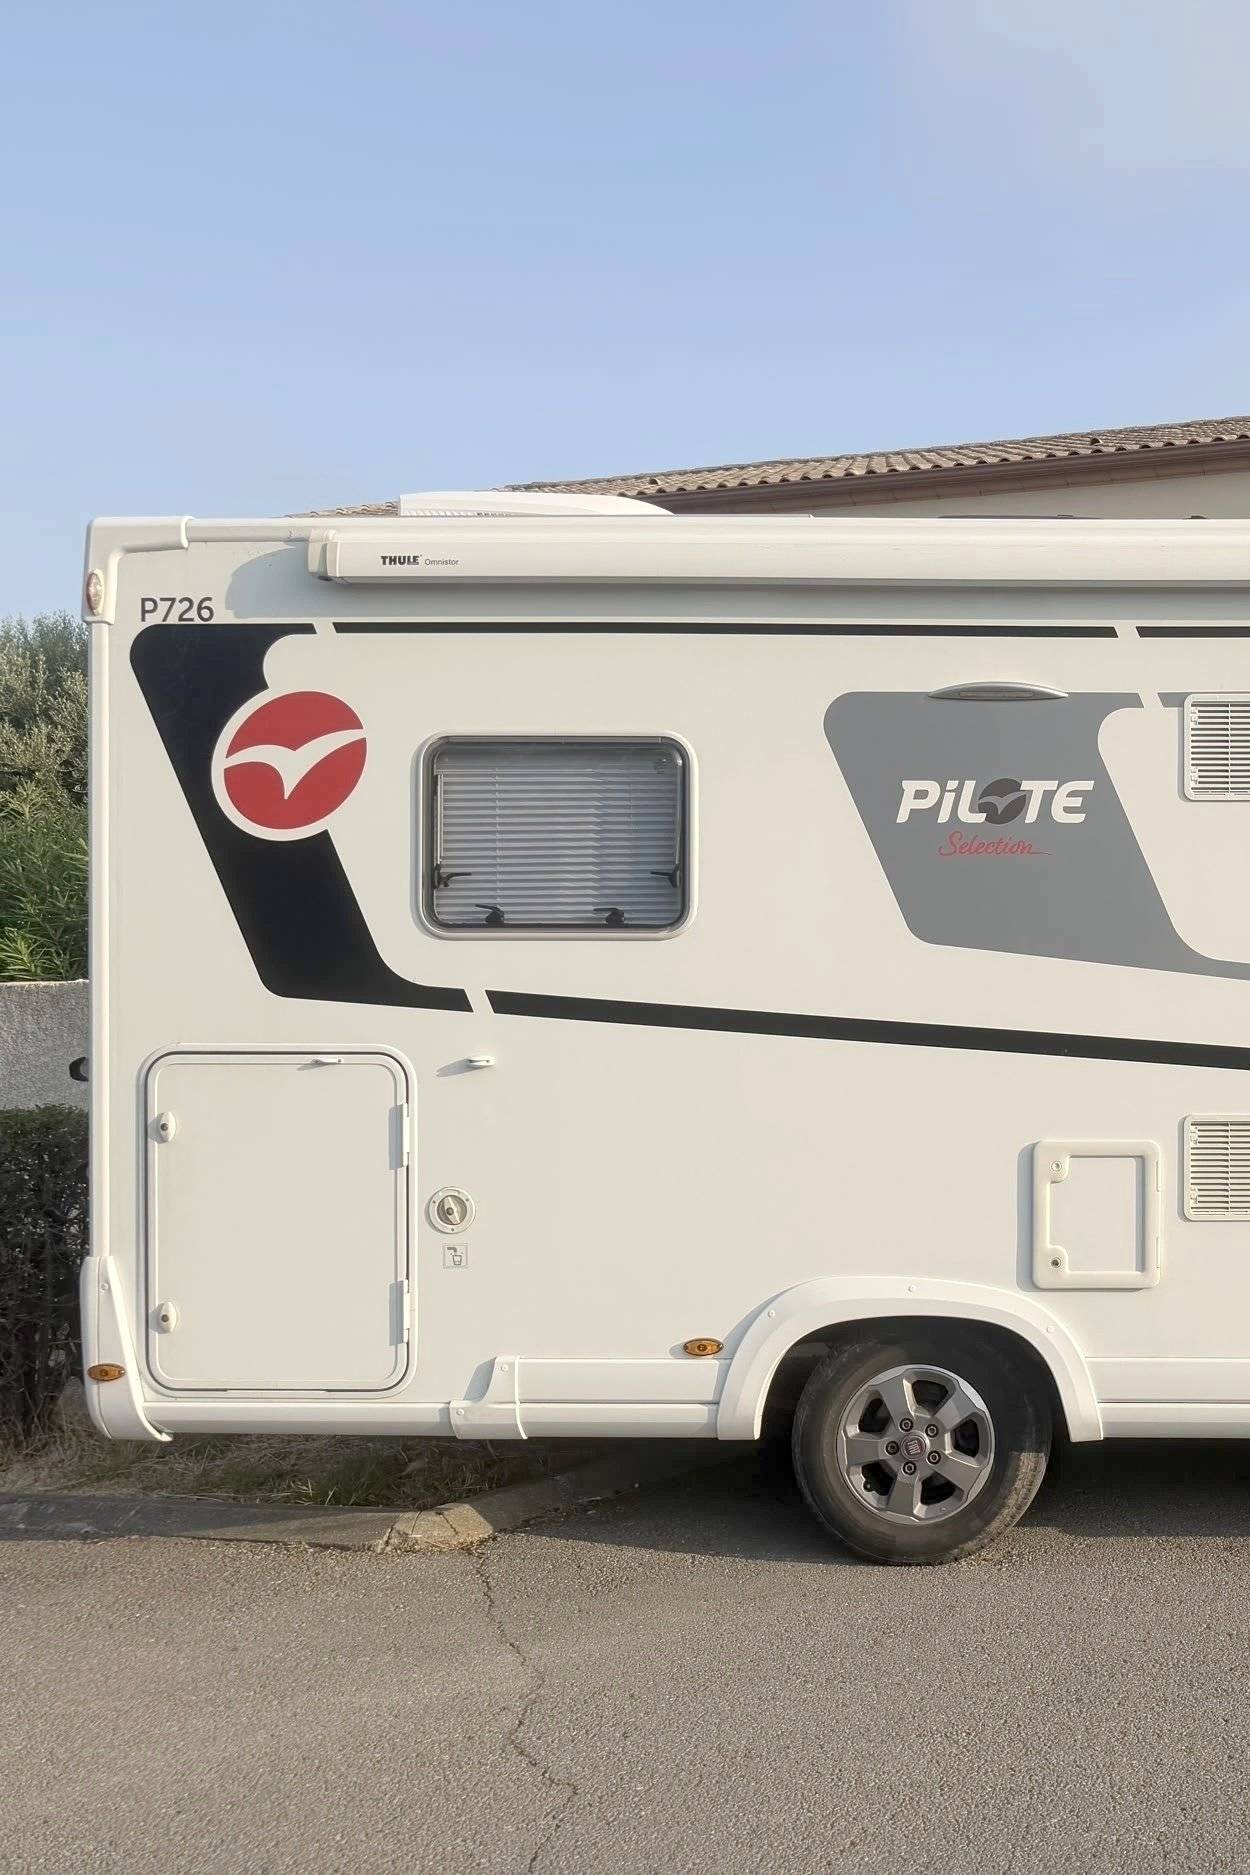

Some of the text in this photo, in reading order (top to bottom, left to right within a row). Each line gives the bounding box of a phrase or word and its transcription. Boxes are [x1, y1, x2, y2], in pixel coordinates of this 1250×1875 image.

[380, 555, 459, 566] THULE Omnistor
[140, 596, 215, 623] P726
[938, 831, 1052, 857] Selection
